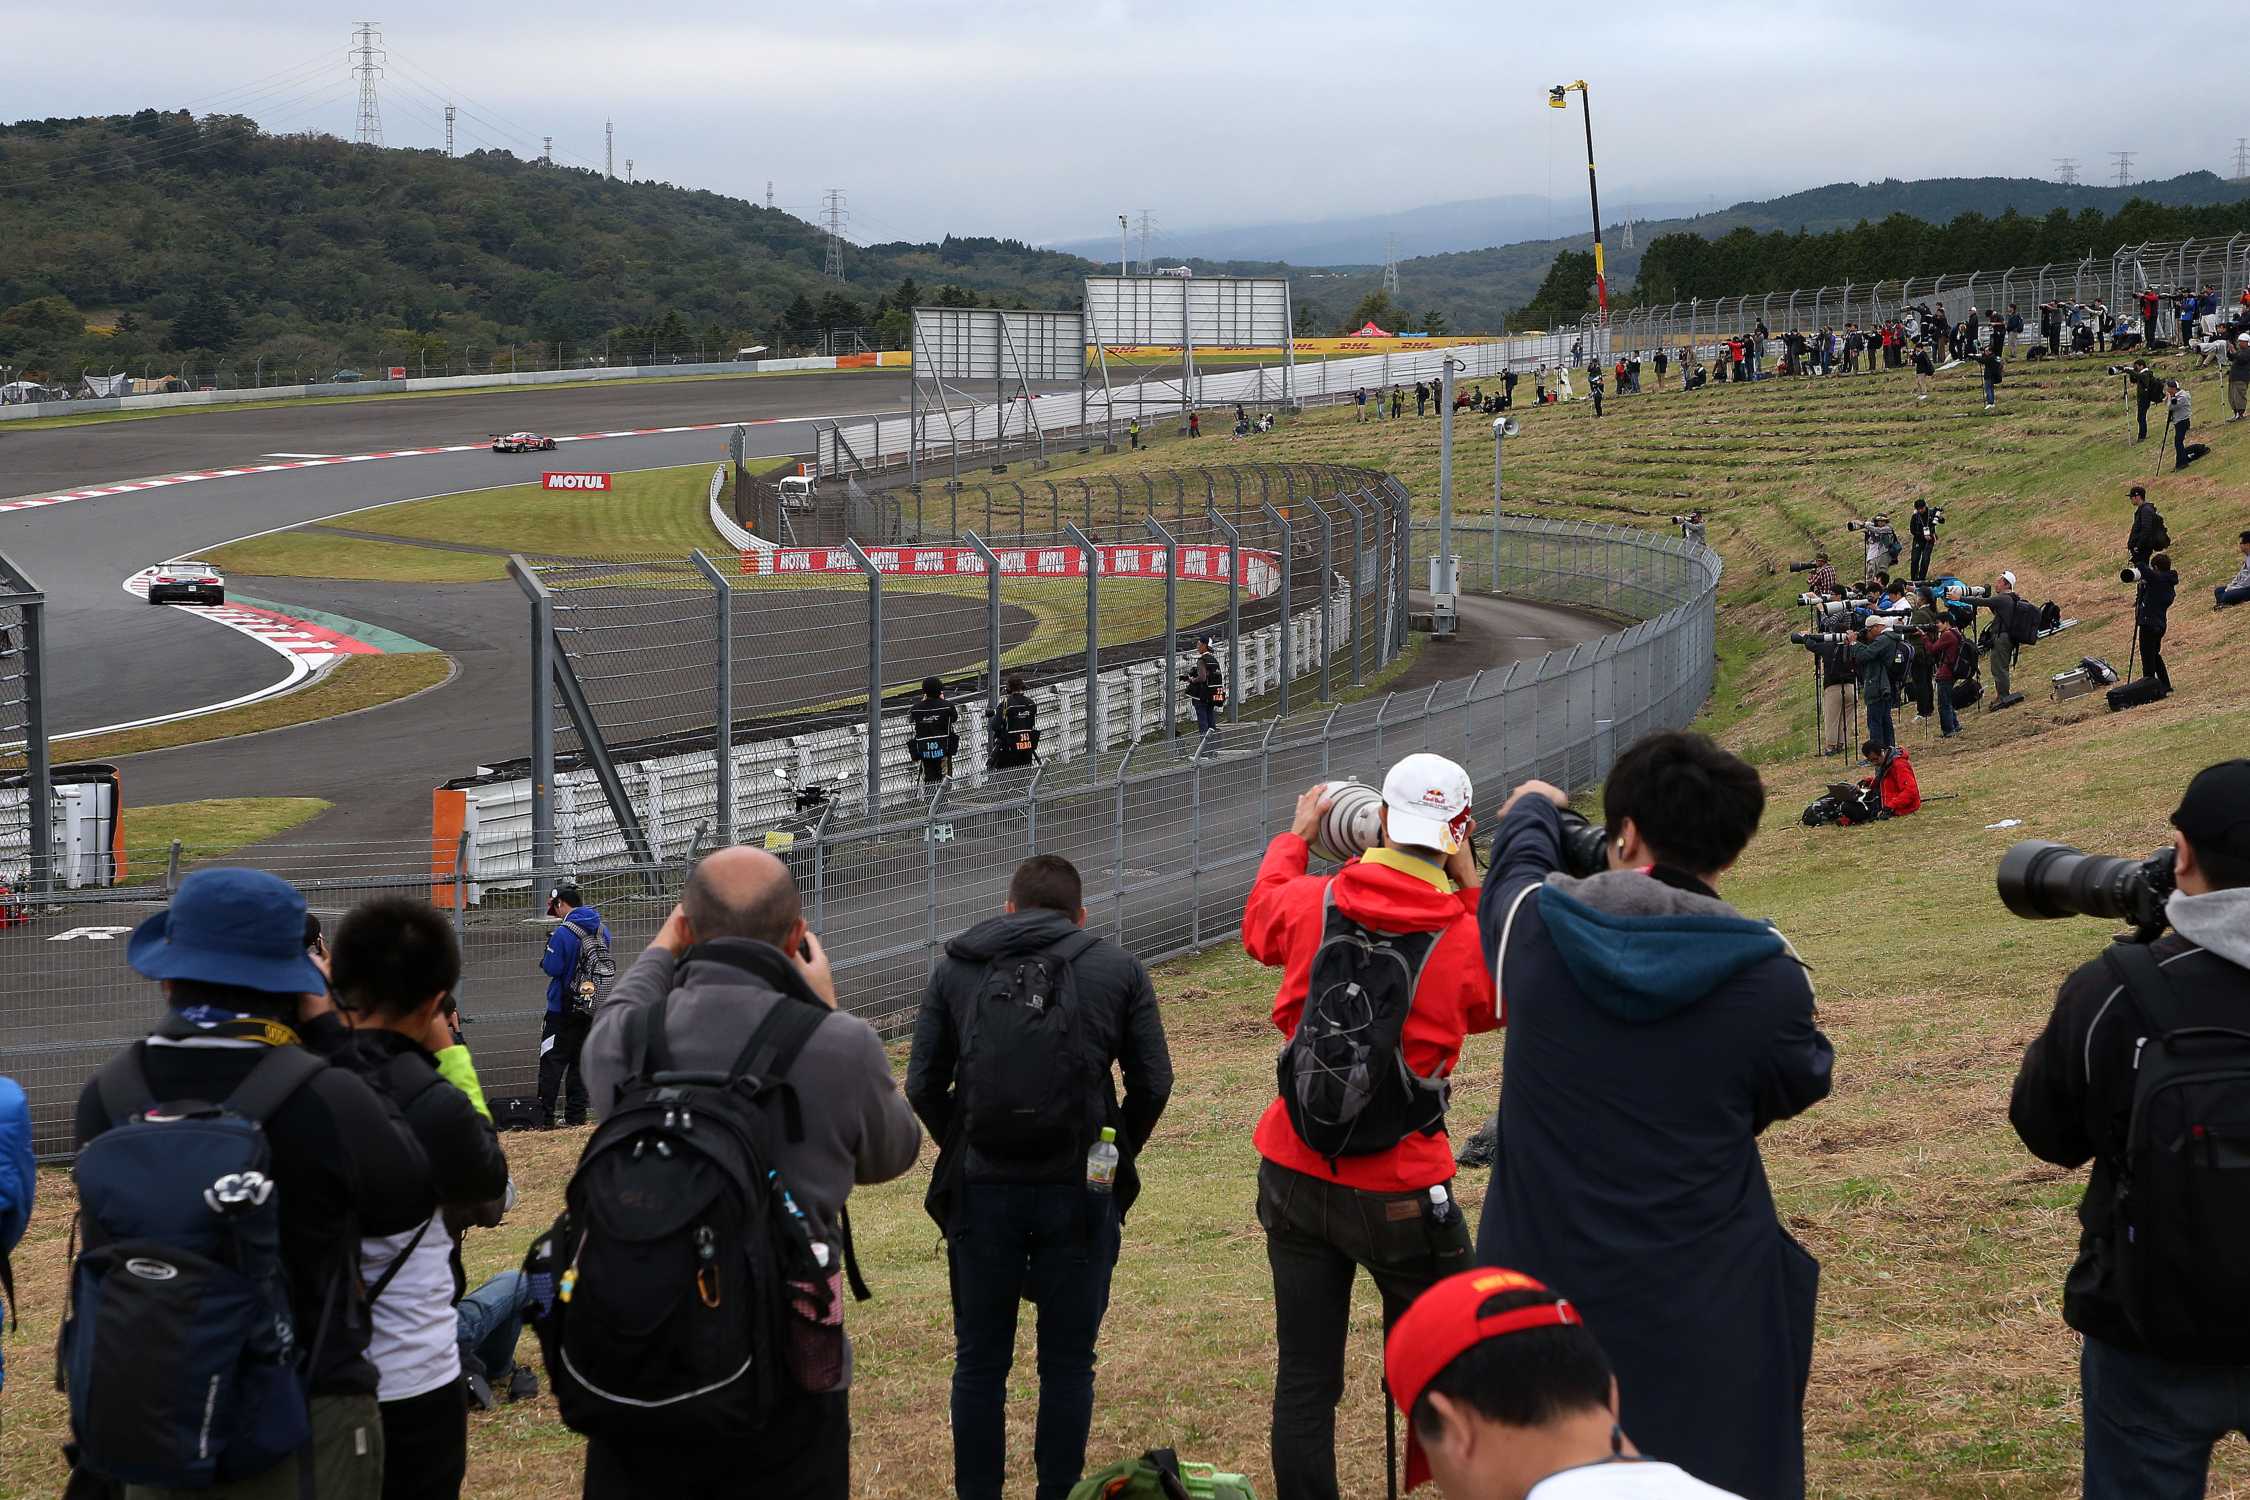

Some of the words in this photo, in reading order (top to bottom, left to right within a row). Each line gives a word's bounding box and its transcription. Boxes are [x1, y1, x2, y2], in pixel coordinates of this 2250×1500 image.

[1339, 342, 1371, 350] DHL
[548, 475, 605, 488] MOTUL
[780, 552, 811, 570] MOTUL
[914, 551, 945, 571] MOTUL
[1037, 551, 1065, 573] MOTUL
